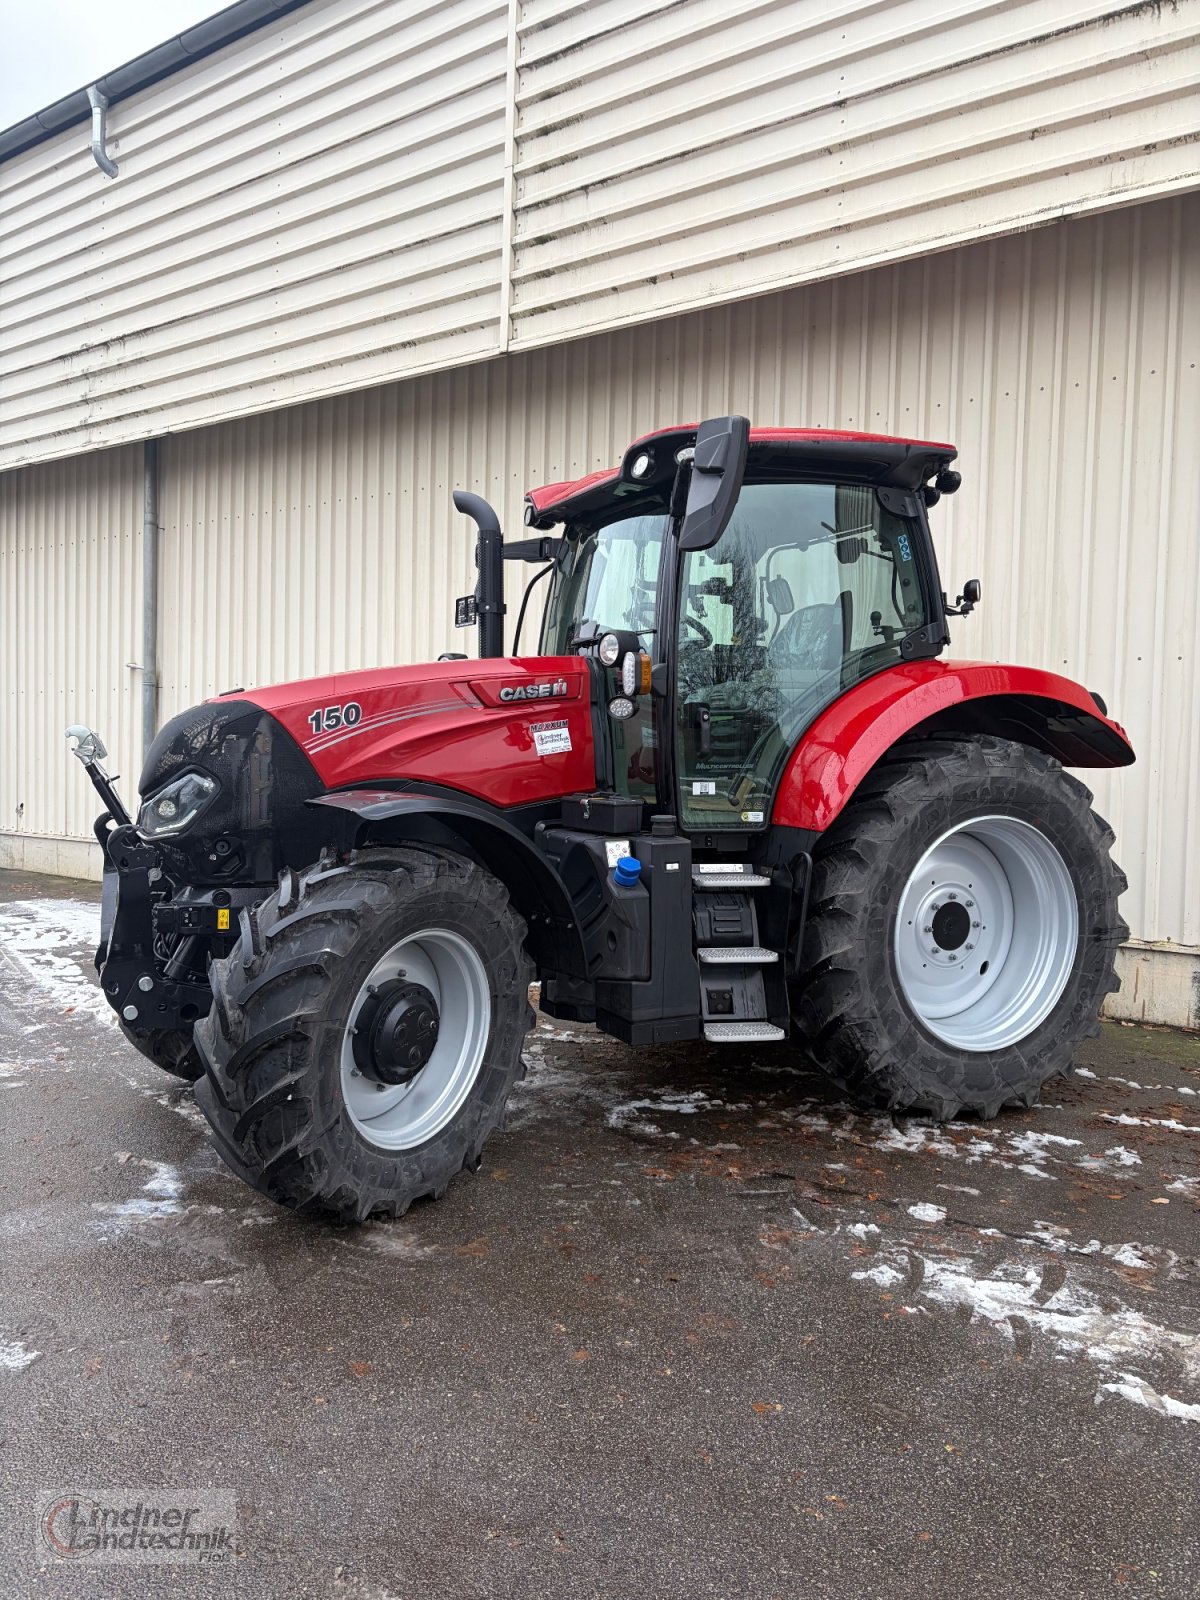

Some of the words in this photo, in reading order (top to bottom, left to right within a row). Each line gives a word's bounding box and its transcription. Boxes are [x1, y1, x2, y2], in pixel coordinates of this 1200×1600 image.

[499, 686, 549, 702] CASE
[308, 702, 362, 735] 150
[530, 720, 569, 732] MAXXUM
